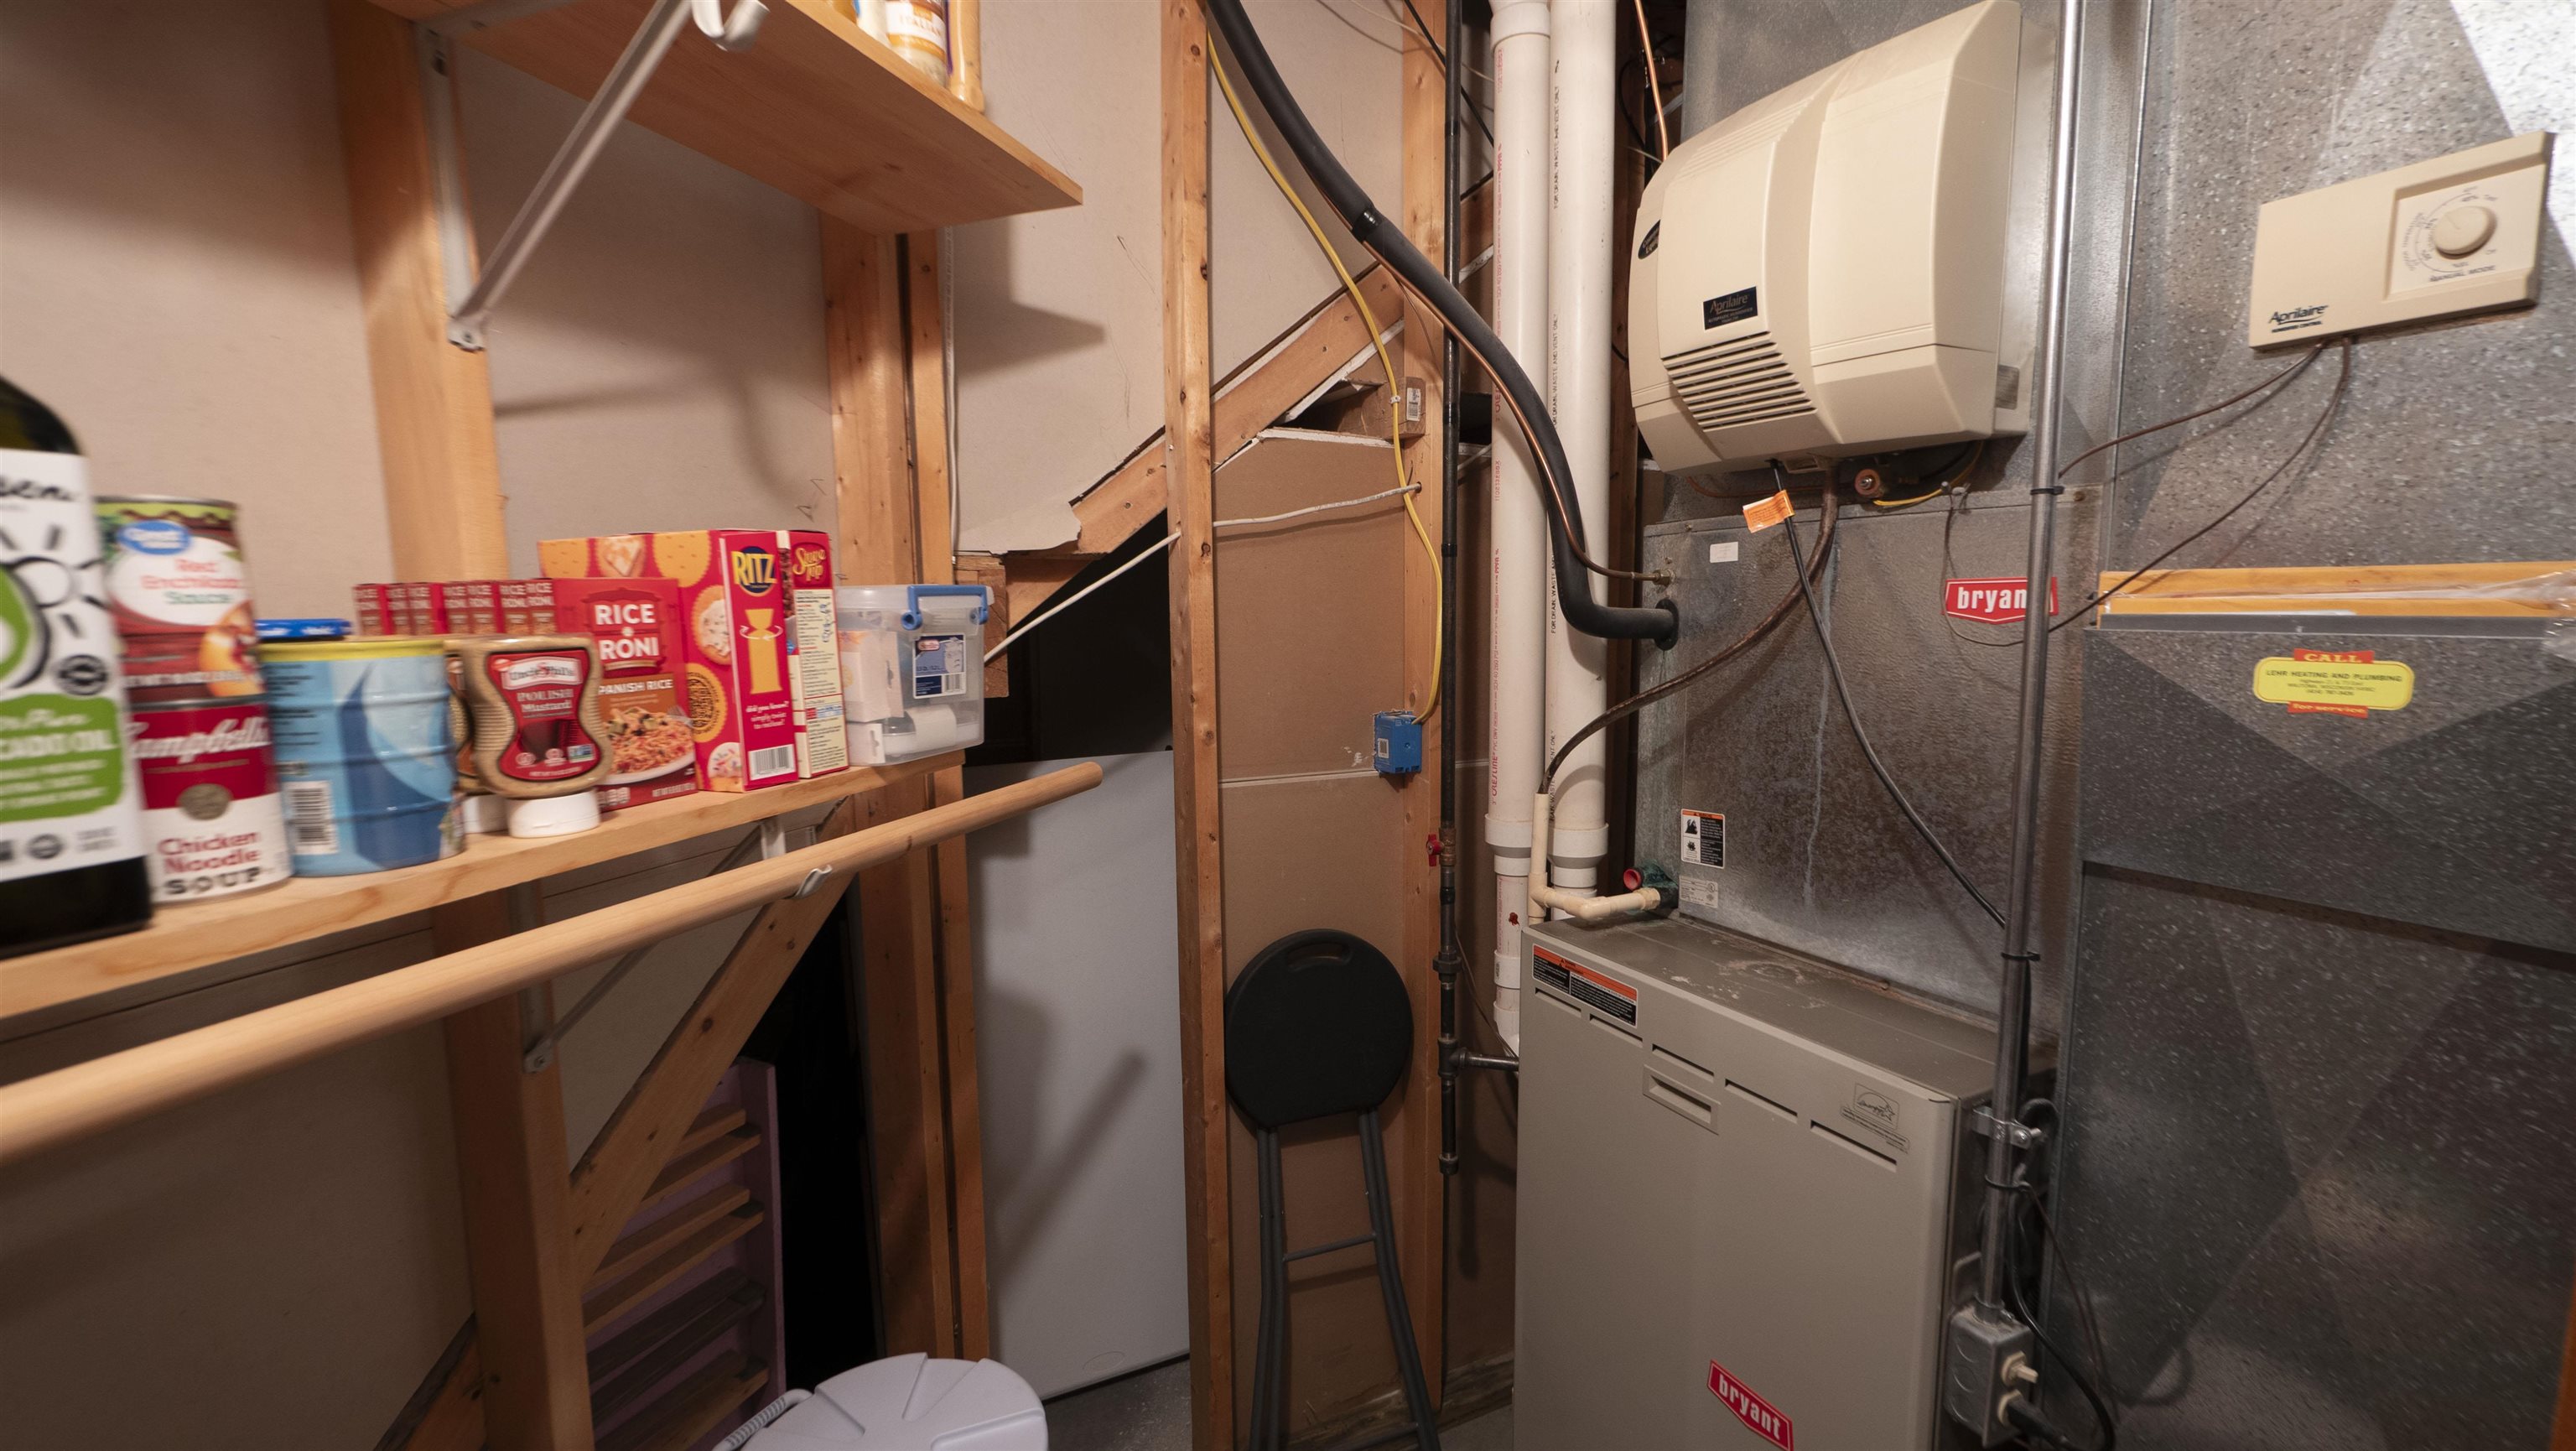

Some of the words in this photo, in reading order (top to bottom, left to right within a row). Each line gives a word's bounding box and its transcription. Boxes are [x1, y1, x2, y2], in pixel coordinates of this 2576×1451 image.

[1709, 294, 1748, 315] Aprilaire
[731, 550, 778, 586] RITZ
[1956, 586, 2028, 613] bryan
[594, 603, 657, 626] RICE
[598, 637, 661, 661] RONI
[2303, 653, 2363, 663] CALL
[598, 681, 646, 695] PANISH
[647, 679, 674, 691] RICE
[2291, 670, 2329, 679] HEATING
[2353, 673, 2403, 682] PLUMBING
[2292, 702, 2313, 711] for
[2314, 705, 2366, 714] service
[158, 831, 261, 856] Chicken
[164, 850, 261, 874] Noodle
[165, 866, 261, 896] SOUP
[1718, 1373, 1781, 1441] bryant
